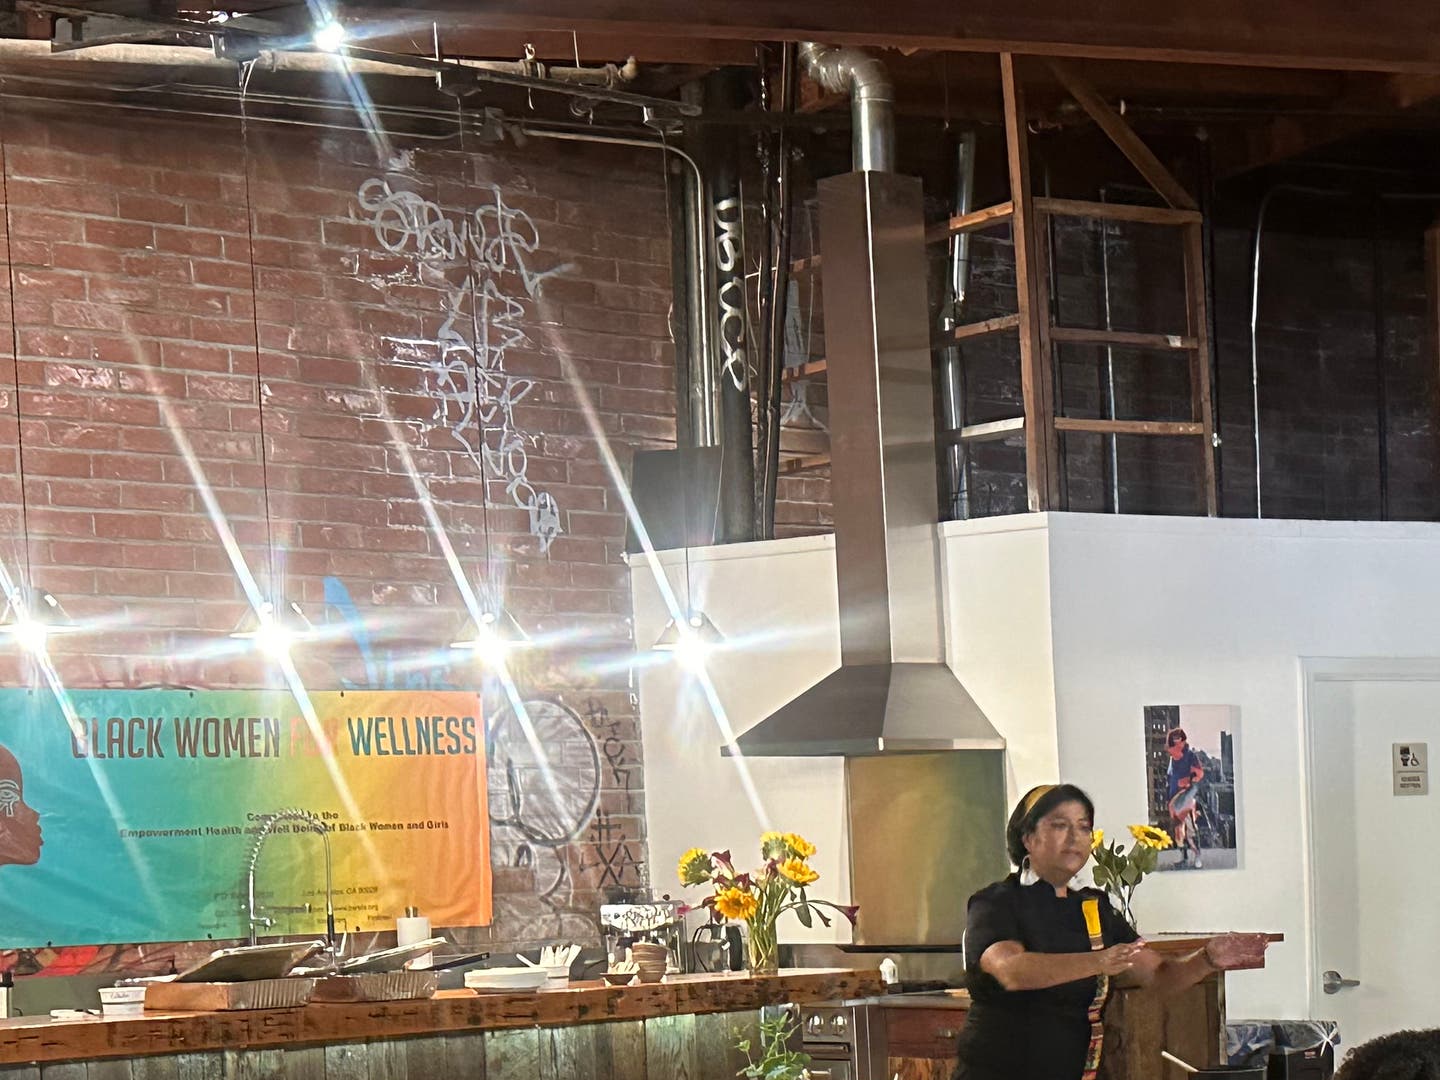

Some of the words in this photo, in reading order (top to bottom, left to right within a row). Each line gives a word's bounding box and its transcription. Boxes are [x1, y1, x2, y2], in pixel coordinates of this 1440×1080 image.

[71, 717, 165, 759] BLACK
[174, 717, 280, 758] WOMEN
[347, 716, 476, 756] WELLNESS
[206, 825, 242, 836] Health
[339, 822, 367, 832] Black
[369, 821, 404, 831] Women
[406, 820, 425, 830] and
[427, 820, 449, 829] Girls
